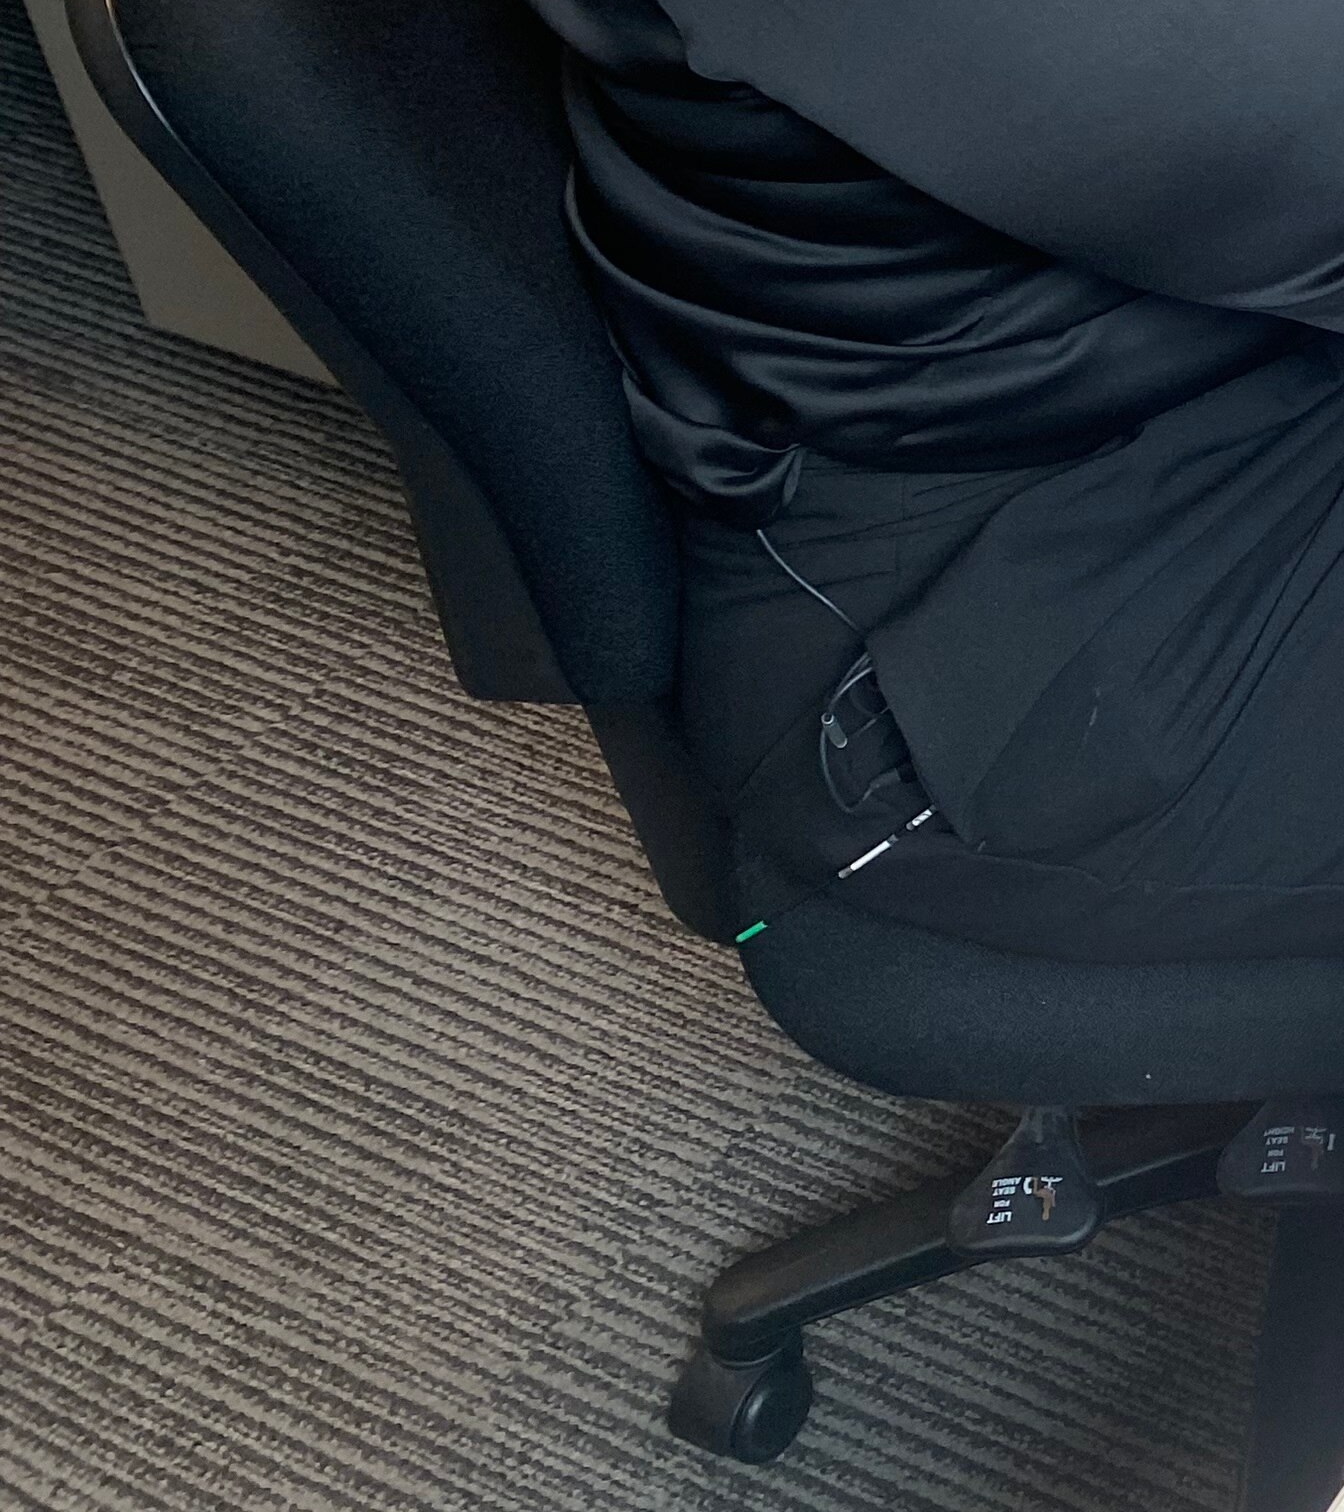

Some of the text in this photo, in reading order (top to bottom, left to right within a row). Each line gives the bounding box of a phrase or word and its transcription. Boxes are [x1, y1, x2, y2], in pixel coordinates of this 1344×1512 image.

[1267, 1148, 1284, 1158] FOR
[1260, 1160, 1286, 1174] LIFT
[992, 1186, 1016, 1197] SEAT
[993, 1199, 1010, 1209] FOR
[986, 1210, 1012, 1224] LIFT
